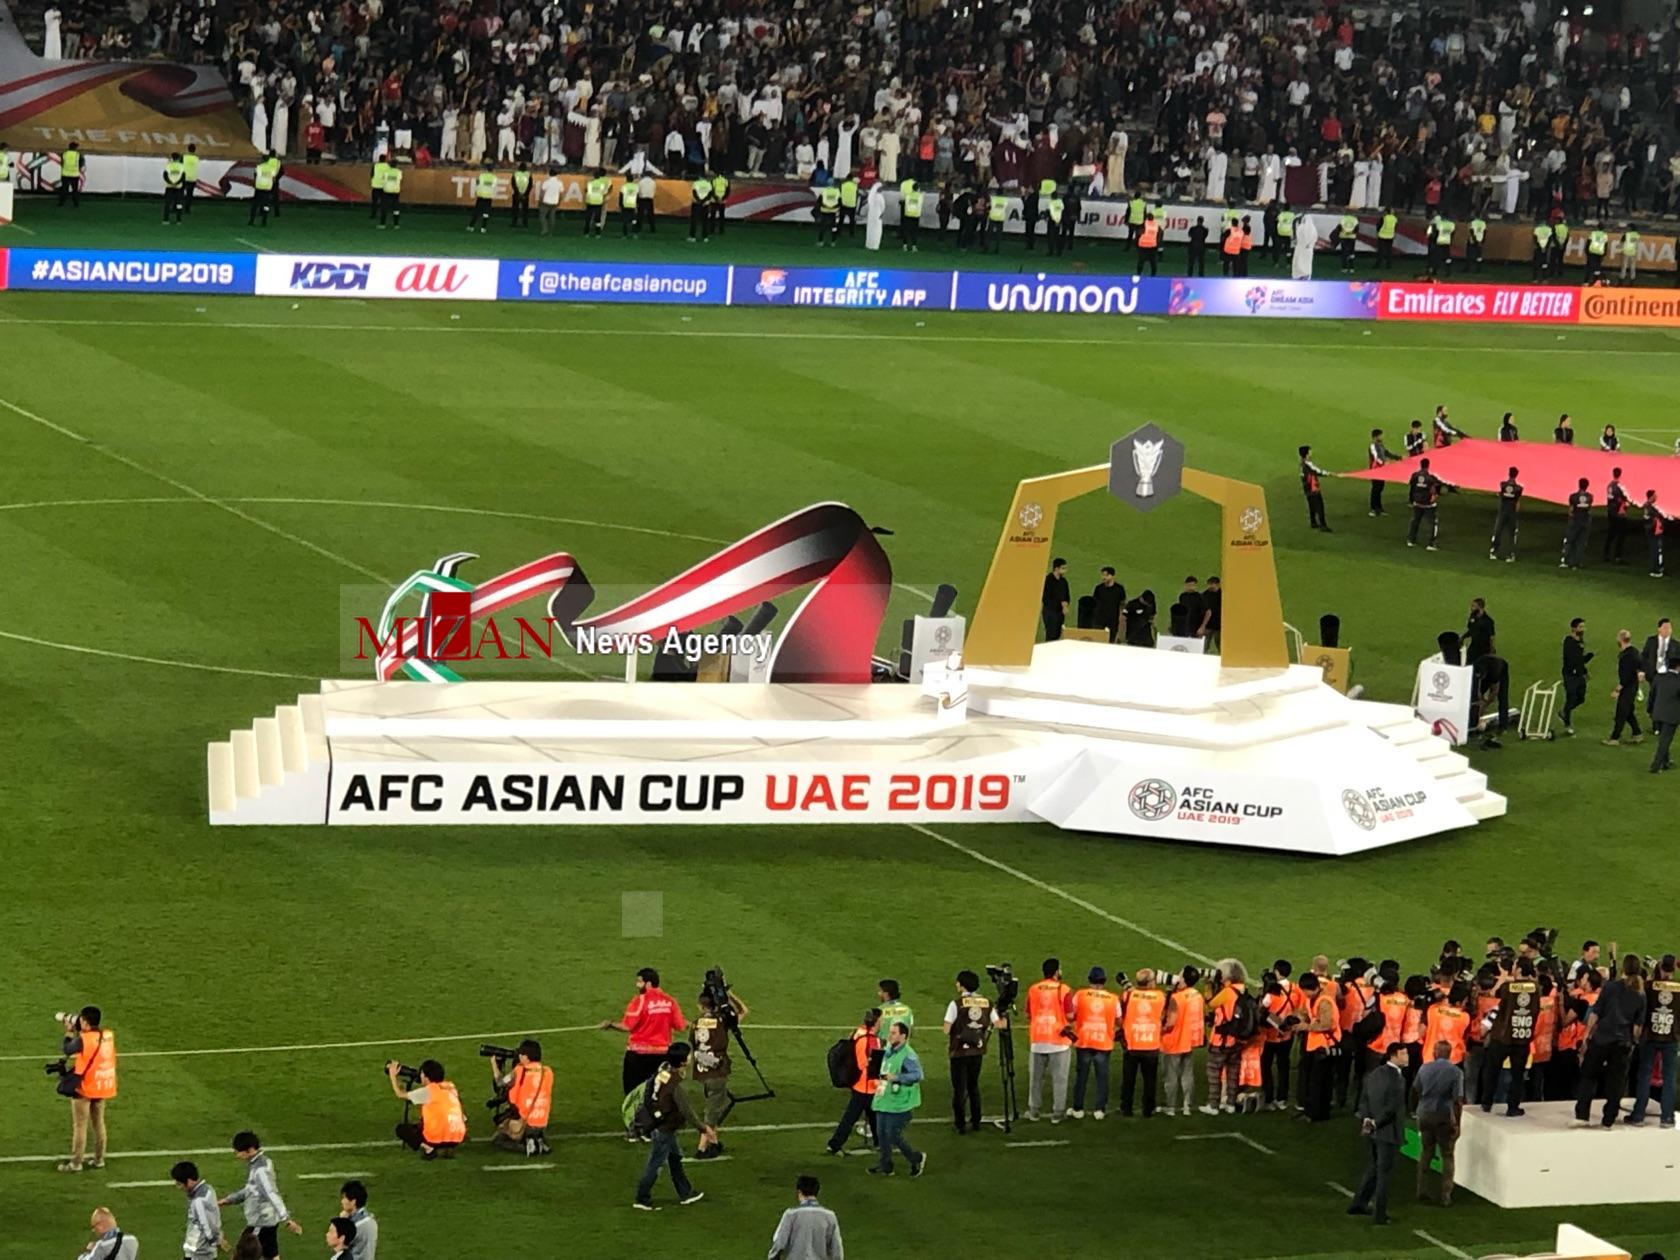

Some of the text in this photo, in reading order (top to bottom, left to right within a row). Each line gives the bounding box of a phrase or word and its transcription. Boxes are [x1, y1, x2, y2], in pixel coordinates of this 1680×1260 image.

[33, 127, 230, 147] THE FINAL
[31, 260, 233, 284] #ASIANCUP2019
[290, 261, 470, 292] KDDI au
[844, 271, 879, 288] AFC
[540, 271, 707, 297] @theafcasiancup
[987, 273, 1141, 314] unimoni
[794, 286, 927, 307] INTEGRITY APP
[1388, 287, 1573, 317] Emirates FLY BETTER
[339, 774, 444, 812] AFC
[461, 774, 625, 812] ASIAN
[639, 774, 744, 811] CUP
[765, 774, 871, 811] UAE
[888, 774, 1011, 811] 2019
[1181, 786, 1214, 799] AFC
[1366, 787, 1385, 800] AFC
[1373, 791, 1427, 812] ASIAN CUP
[1177, 812, 1241, 825] UAE 2019
[1179, 798, 1283, 818] ASIAN CUP
